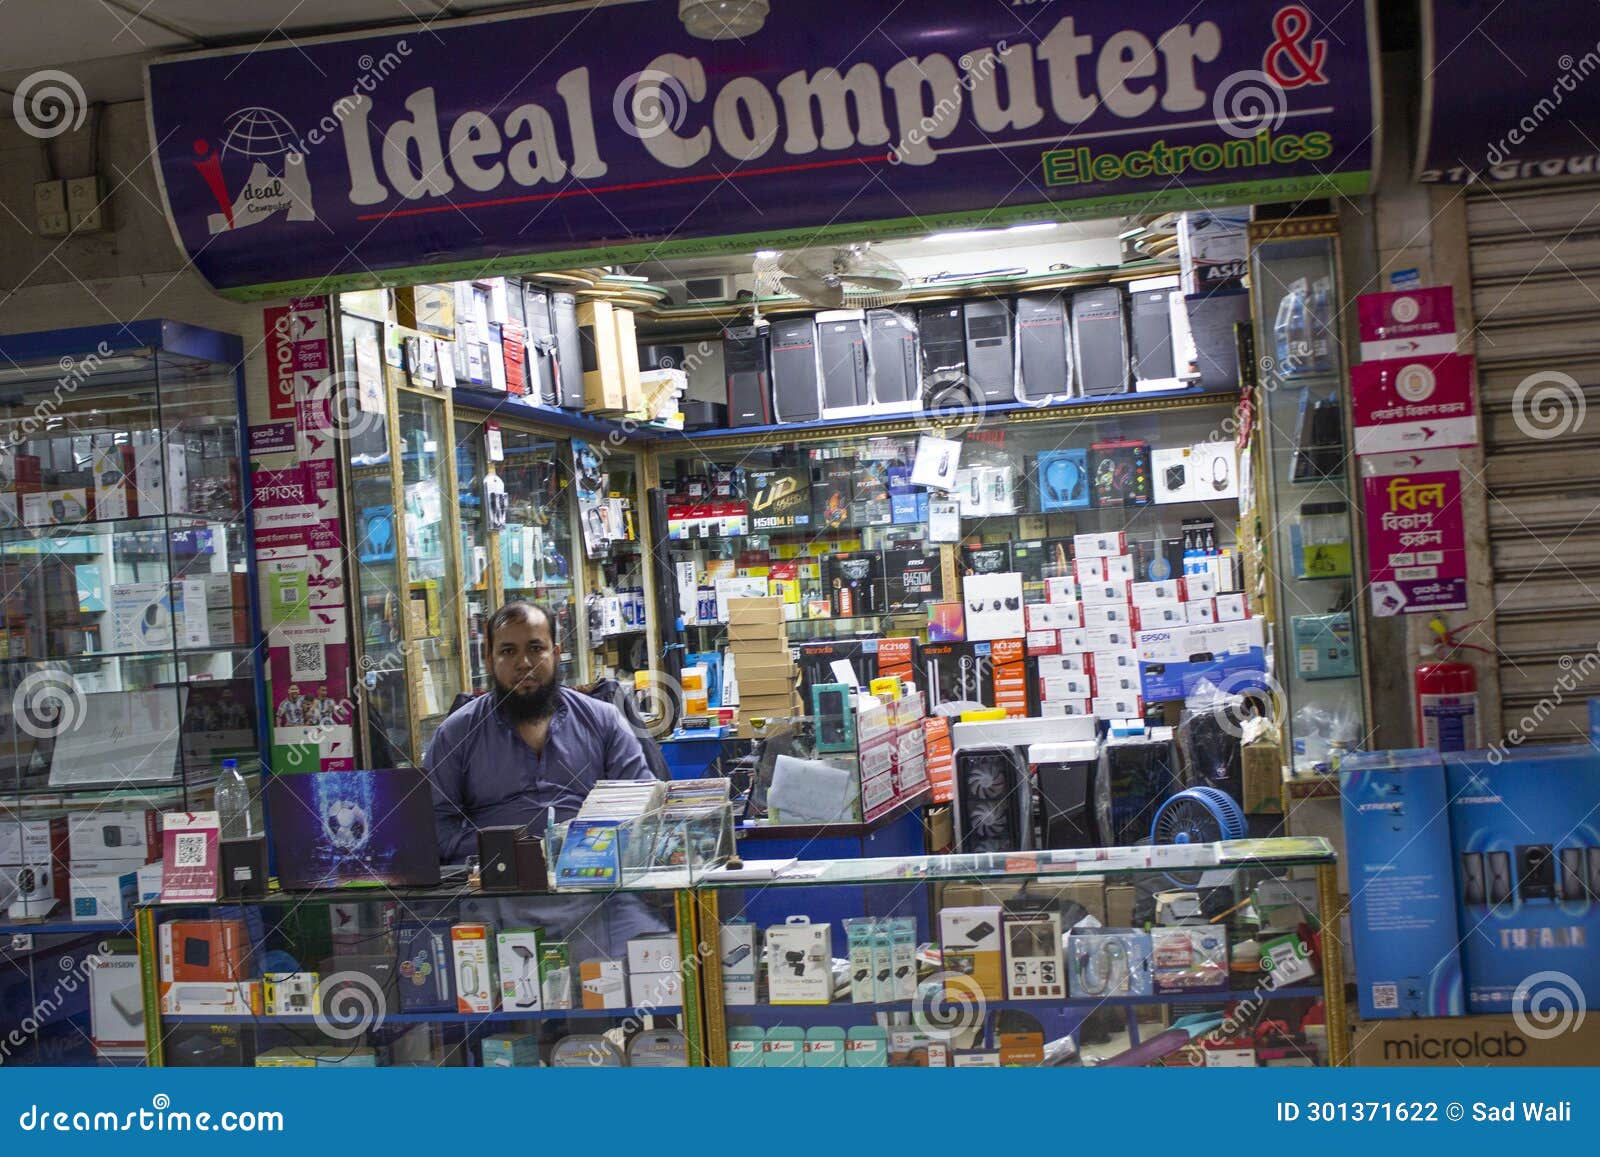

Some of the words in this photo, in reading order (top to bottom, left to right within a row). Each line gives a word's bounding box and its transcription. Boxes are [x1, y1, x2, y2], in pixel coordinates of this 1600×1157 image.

[333, 67, 608, 206] Ideal
[632, 16, 1223, 168] Computer
[1262, 4, 1330, 90] &
[1042, 130, 1333, 187] Electronics
[276, 315, 295, 409] Lenovo
[1386, 477, 1447, 512] বিল
[1381, 511, 1434, 531] বিকাশ
[1141, 633, 1171, 642] EPSON
[1383, 1031, 1528, 1060] microlab
